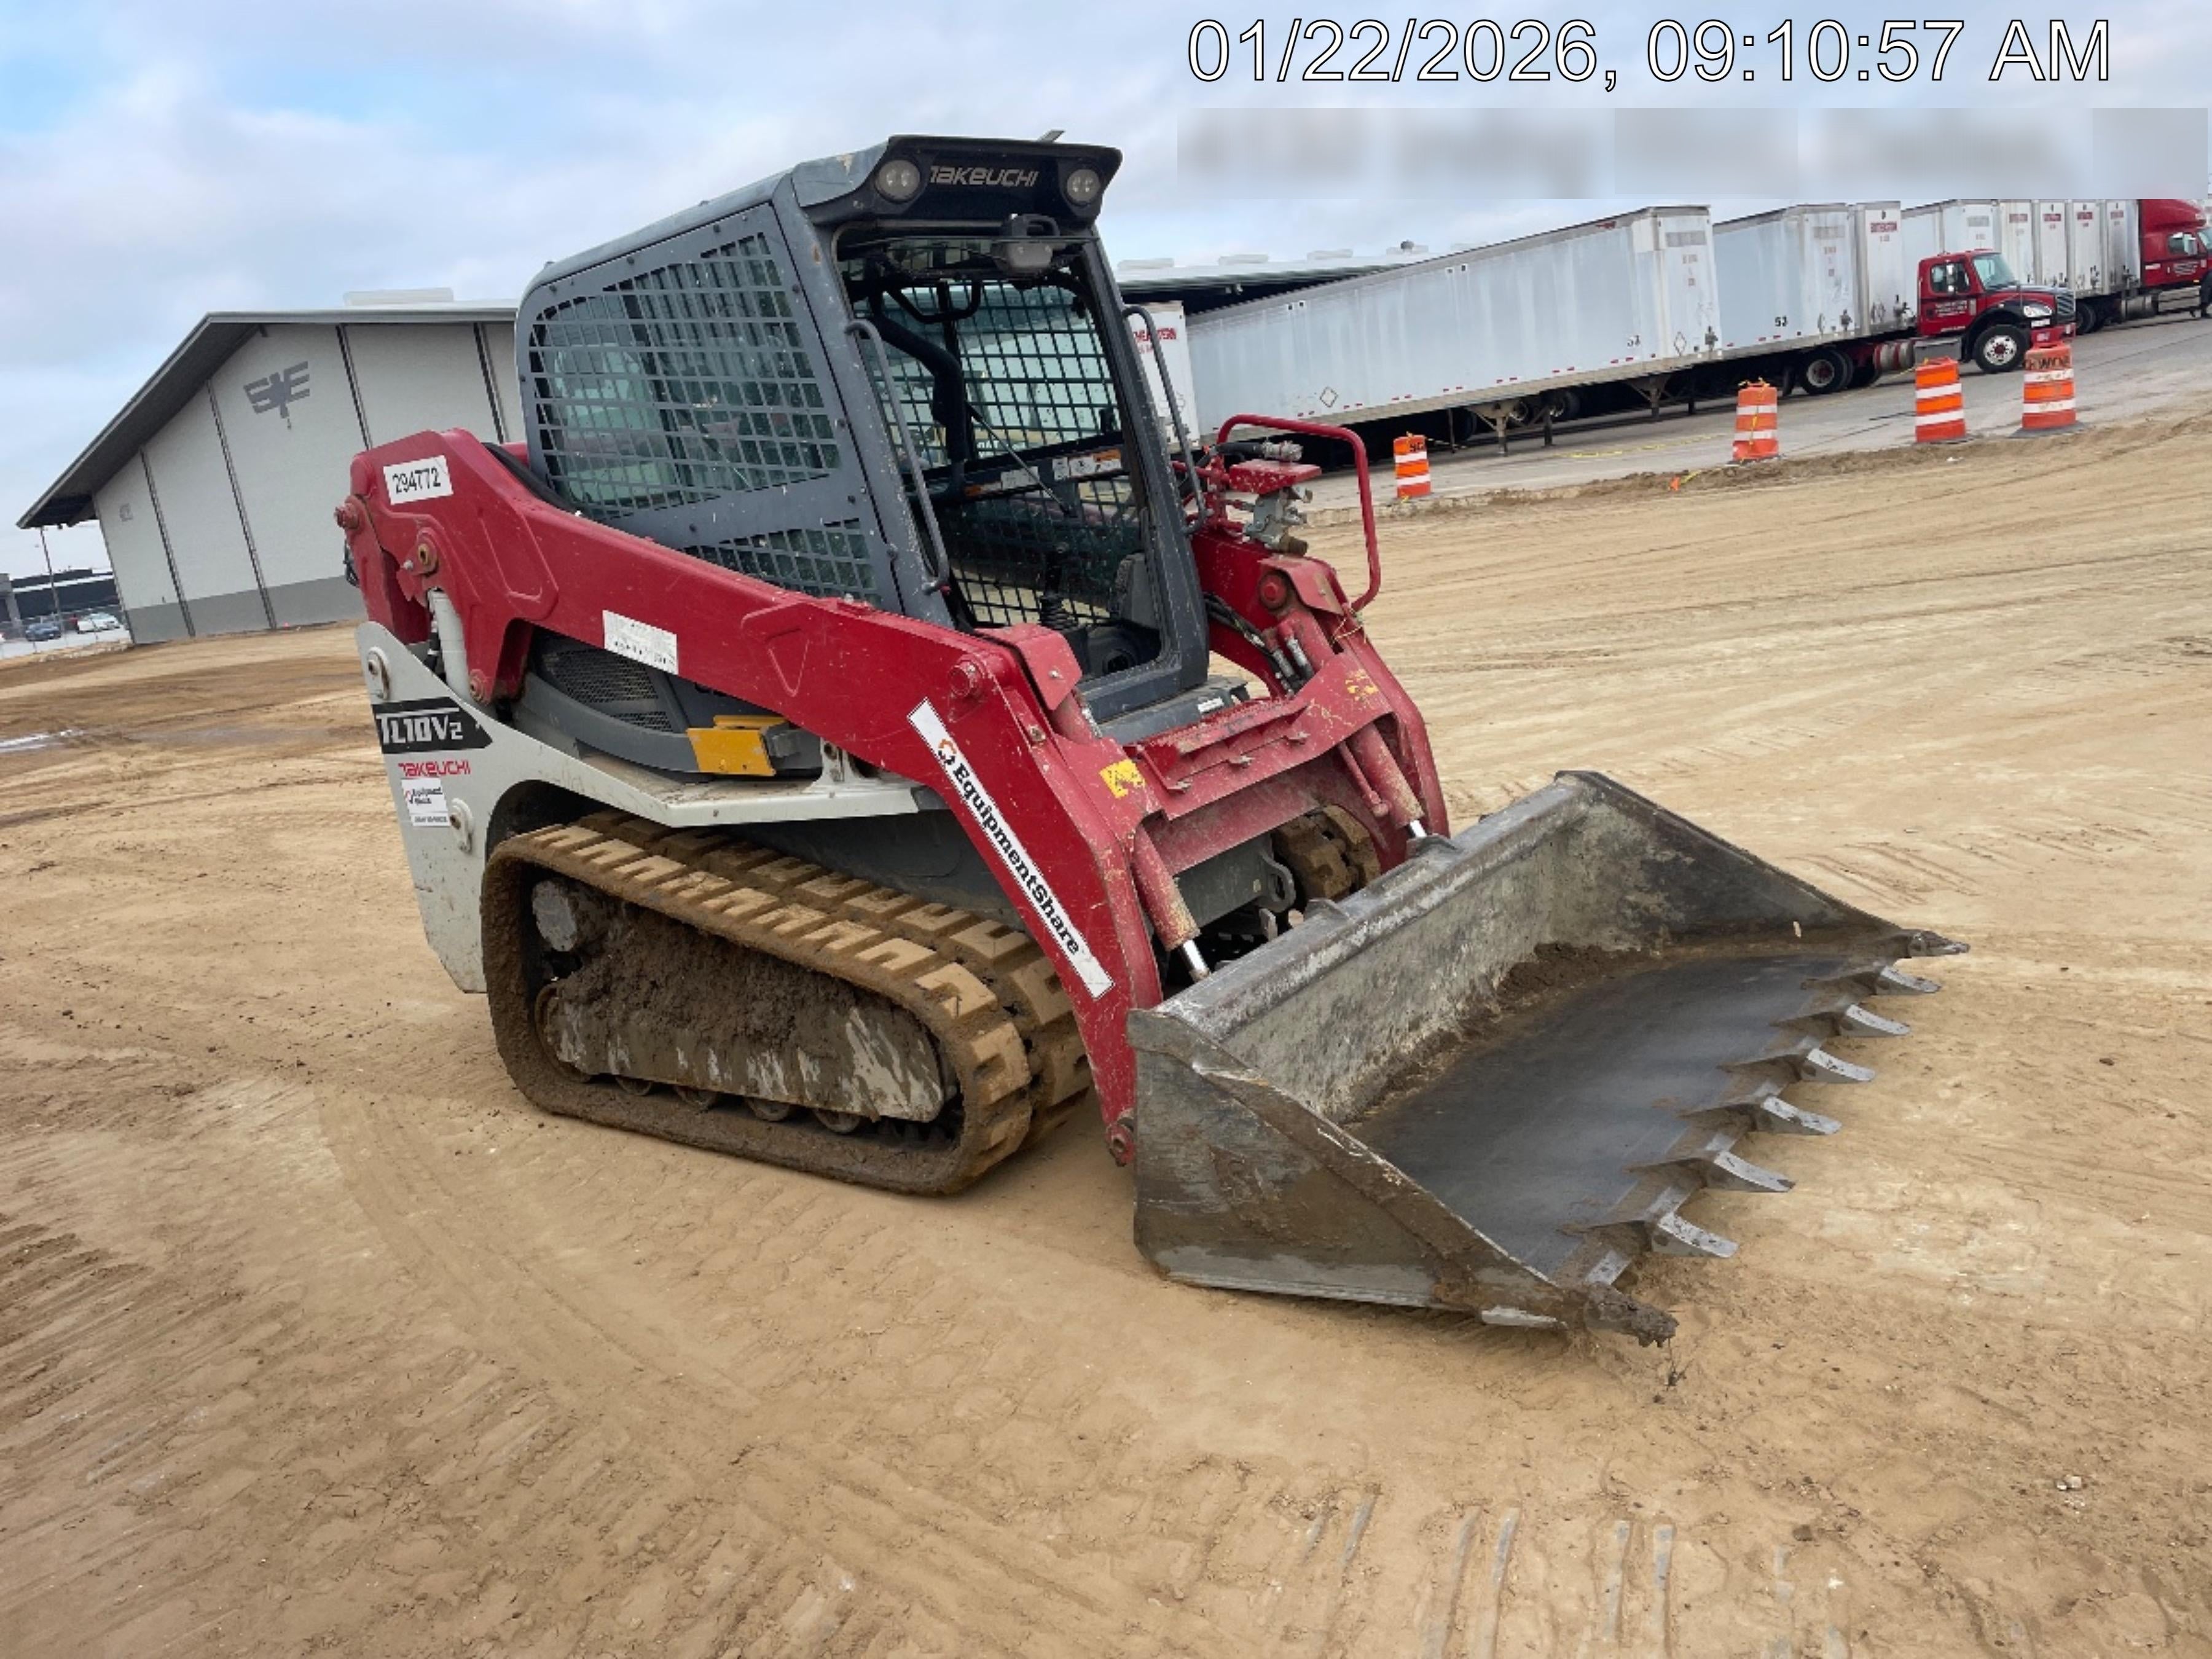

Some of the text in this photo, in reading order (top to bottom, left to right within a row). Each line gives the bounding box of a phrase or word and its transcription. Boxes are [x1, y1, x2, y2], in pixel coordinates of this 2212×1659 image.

[930, 166, 1039, 187] TAKEUCHI
[393, 467, 441, 494] 294772
[952, 762, 1080, 955] EquipmentShare
